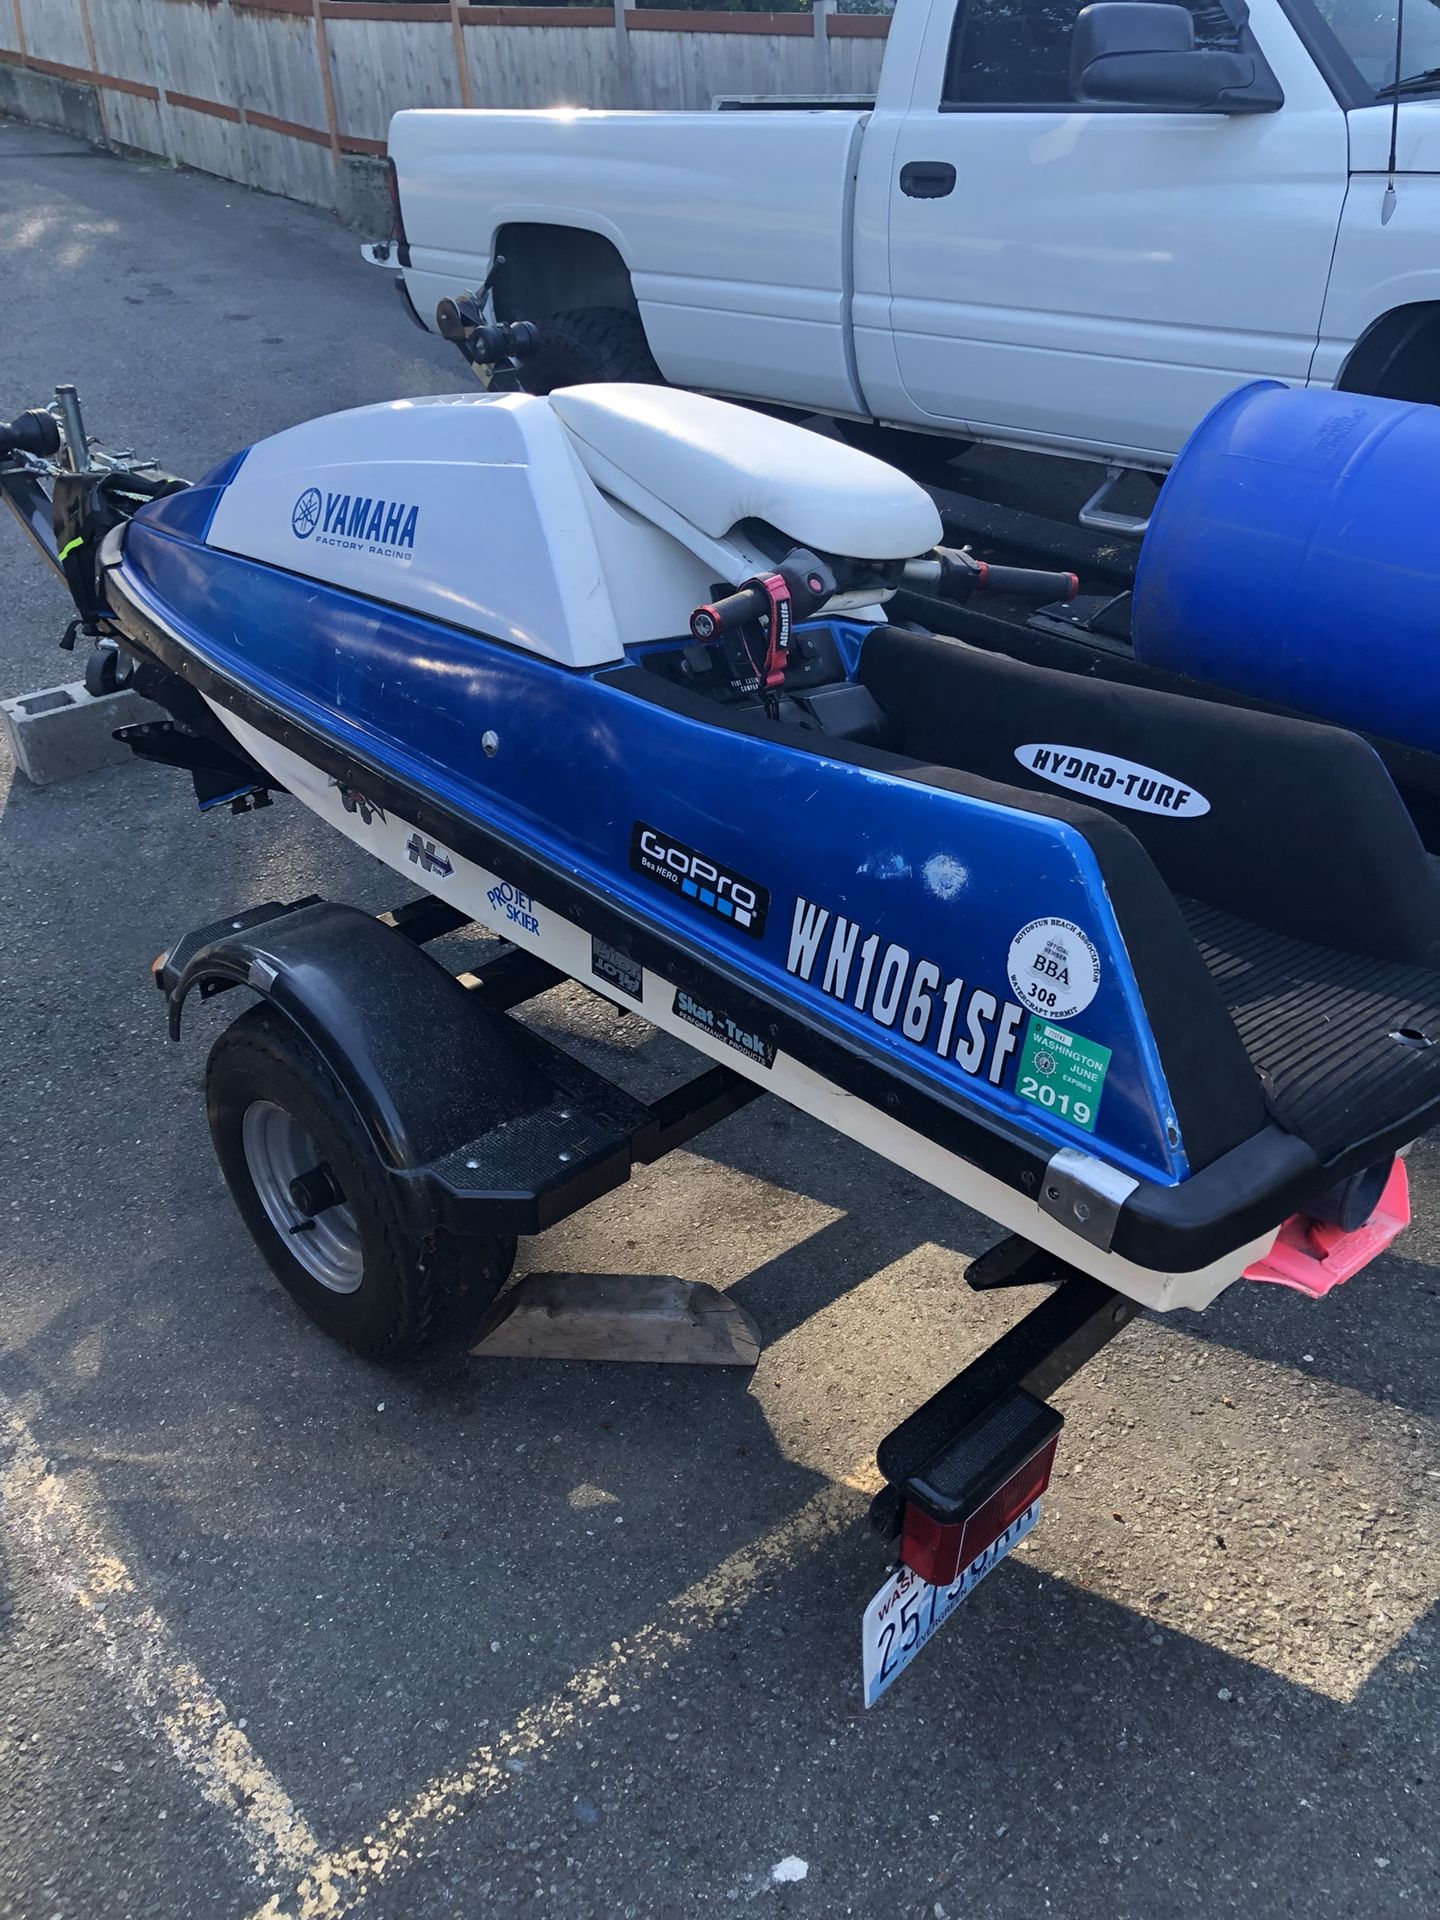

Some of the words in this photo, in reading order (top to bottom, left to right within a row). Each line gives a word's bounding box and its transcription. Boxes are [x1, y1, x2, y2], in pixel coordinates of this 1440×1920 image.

[322, 492, 419, 549] YAMAHA
[315, 536, 364, 552] FACTORY
[368, 545, 412, 561] RACING
[779, 601, 789, 647] Atlantis
[1031, 749, 1191, 811] HYDRO-TURF
[506, 903, 540, 936] SKIER
[514, 889, 533, 913] JET
[1014, 919, 1049, 945] BOYDSTUN
[1050, 919, 1077, 933] BEACH
[1076, 931, 1100, 984] ASSOCIATION
[1044, 946, 1067, 961] MEMBER
[1046, 940, 1069, 956] OFFICIAL
[1032, 953, 1069, 986] BBA
[786, 896, 1023, 1084] WN1061SF
[1010, 974, 1048, 1016] WATERCRAFT
[1050, 1006, 1078, 1018] PERMIT
[1027, 982, 1057, 1008] 308
[679, 1011, 728, 1044] PERFORMANCE
[728, 1039, 766, 1066] PRODUCTS
[1033, 1032, 1103, 1071] WASHINGTON
[1062, 1074, 1092, 1092] EXPIRES
[1070, 1064, 1098, 1082] JUNE
[1020, 1076, 1091, 1124] 2019
[915, 1587, 967, 1649] EVERGREEN
